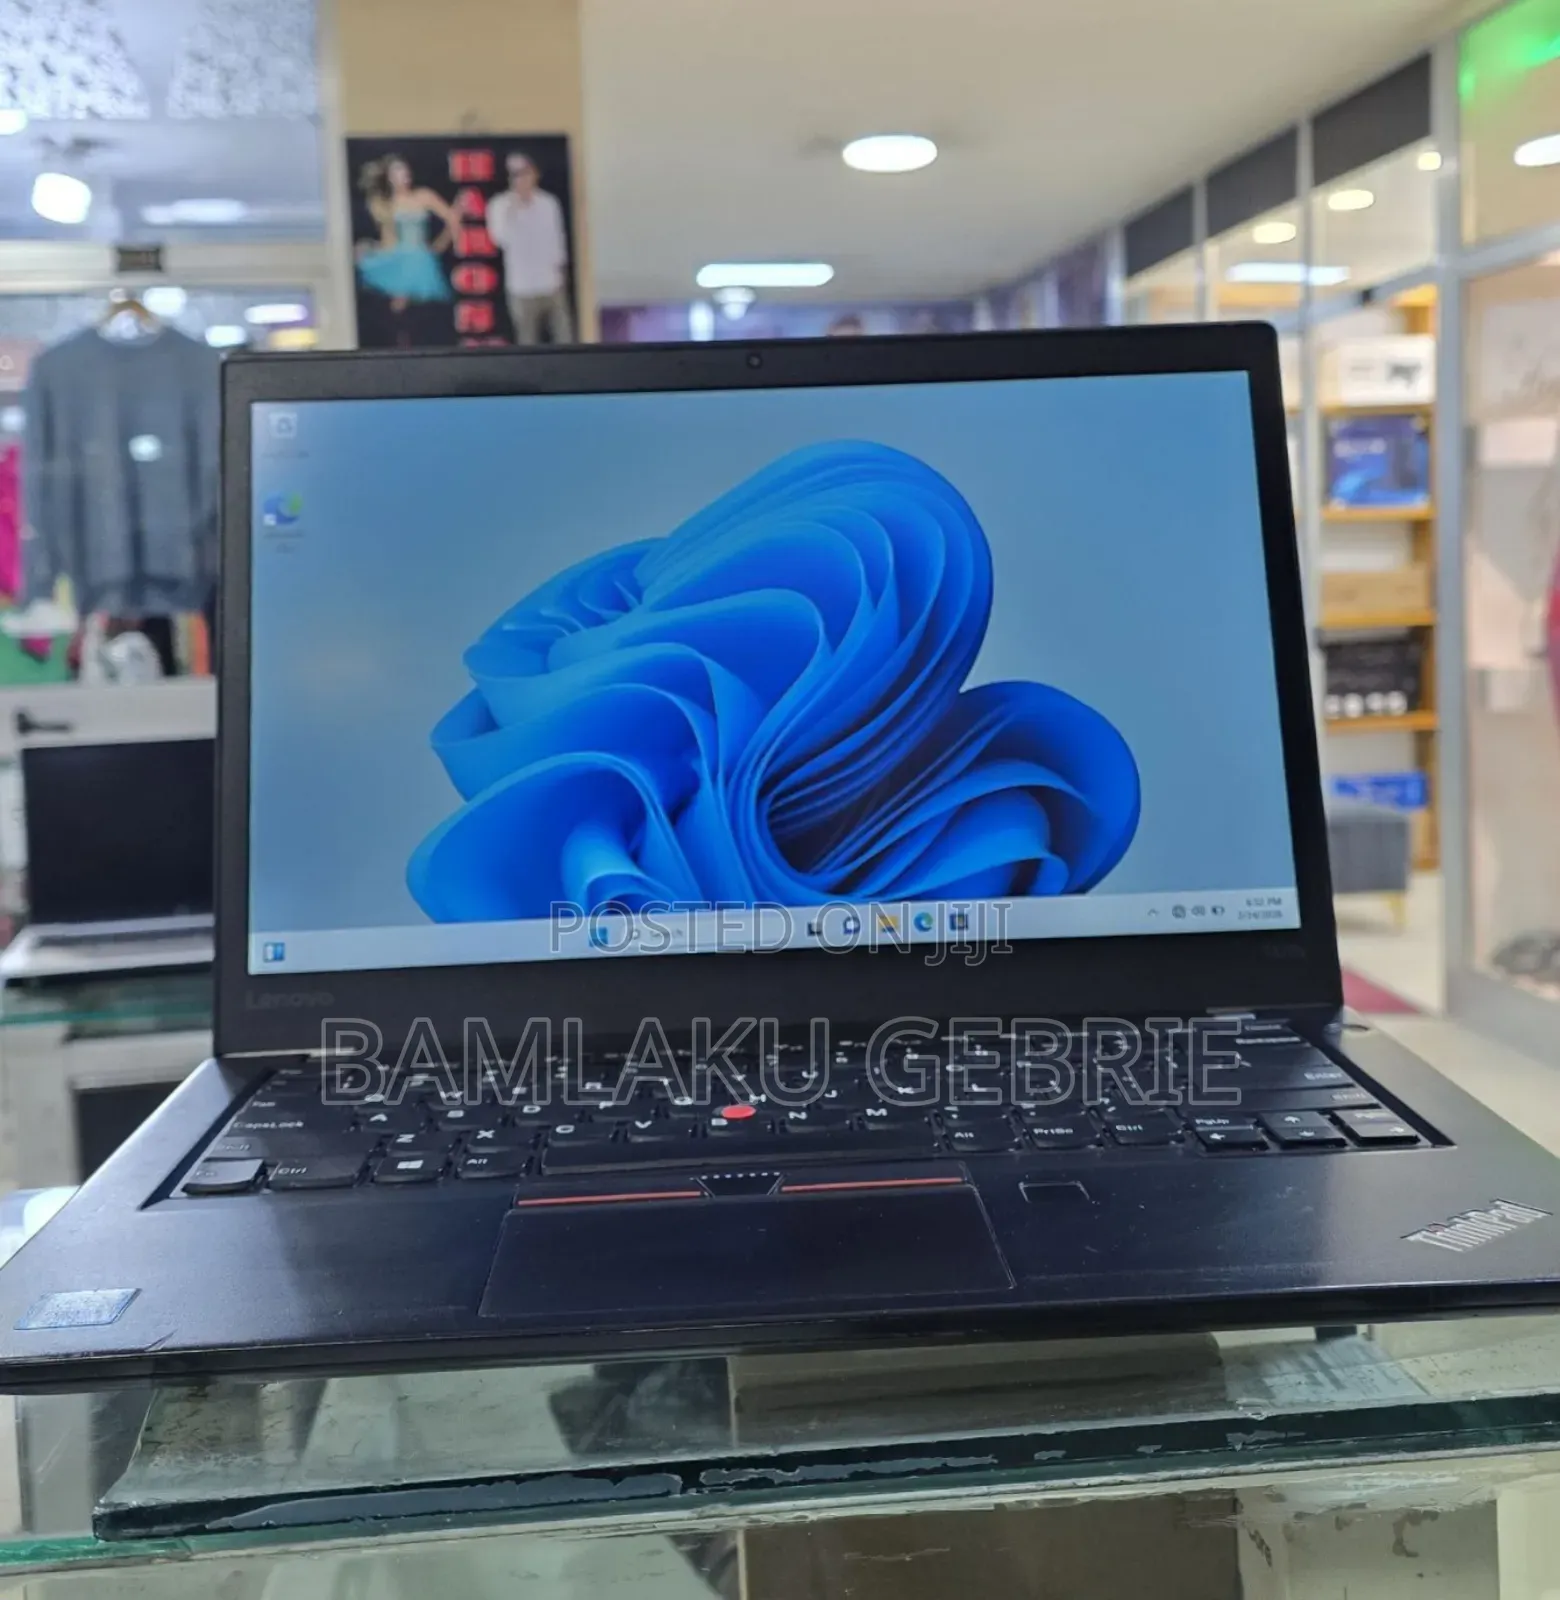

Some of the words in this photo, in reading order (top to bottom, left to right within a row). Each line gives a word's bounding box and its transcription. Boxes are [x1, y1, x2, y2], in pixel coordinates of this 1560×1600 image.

[789, 1110, 809, 1120] N
[865, 1107, 888, 1117] M
[396, 1133, 417, 1143] Z
[476, 1128, 497, 1139] X
[1401, 1197, 1553, 1253] ThinkPad
